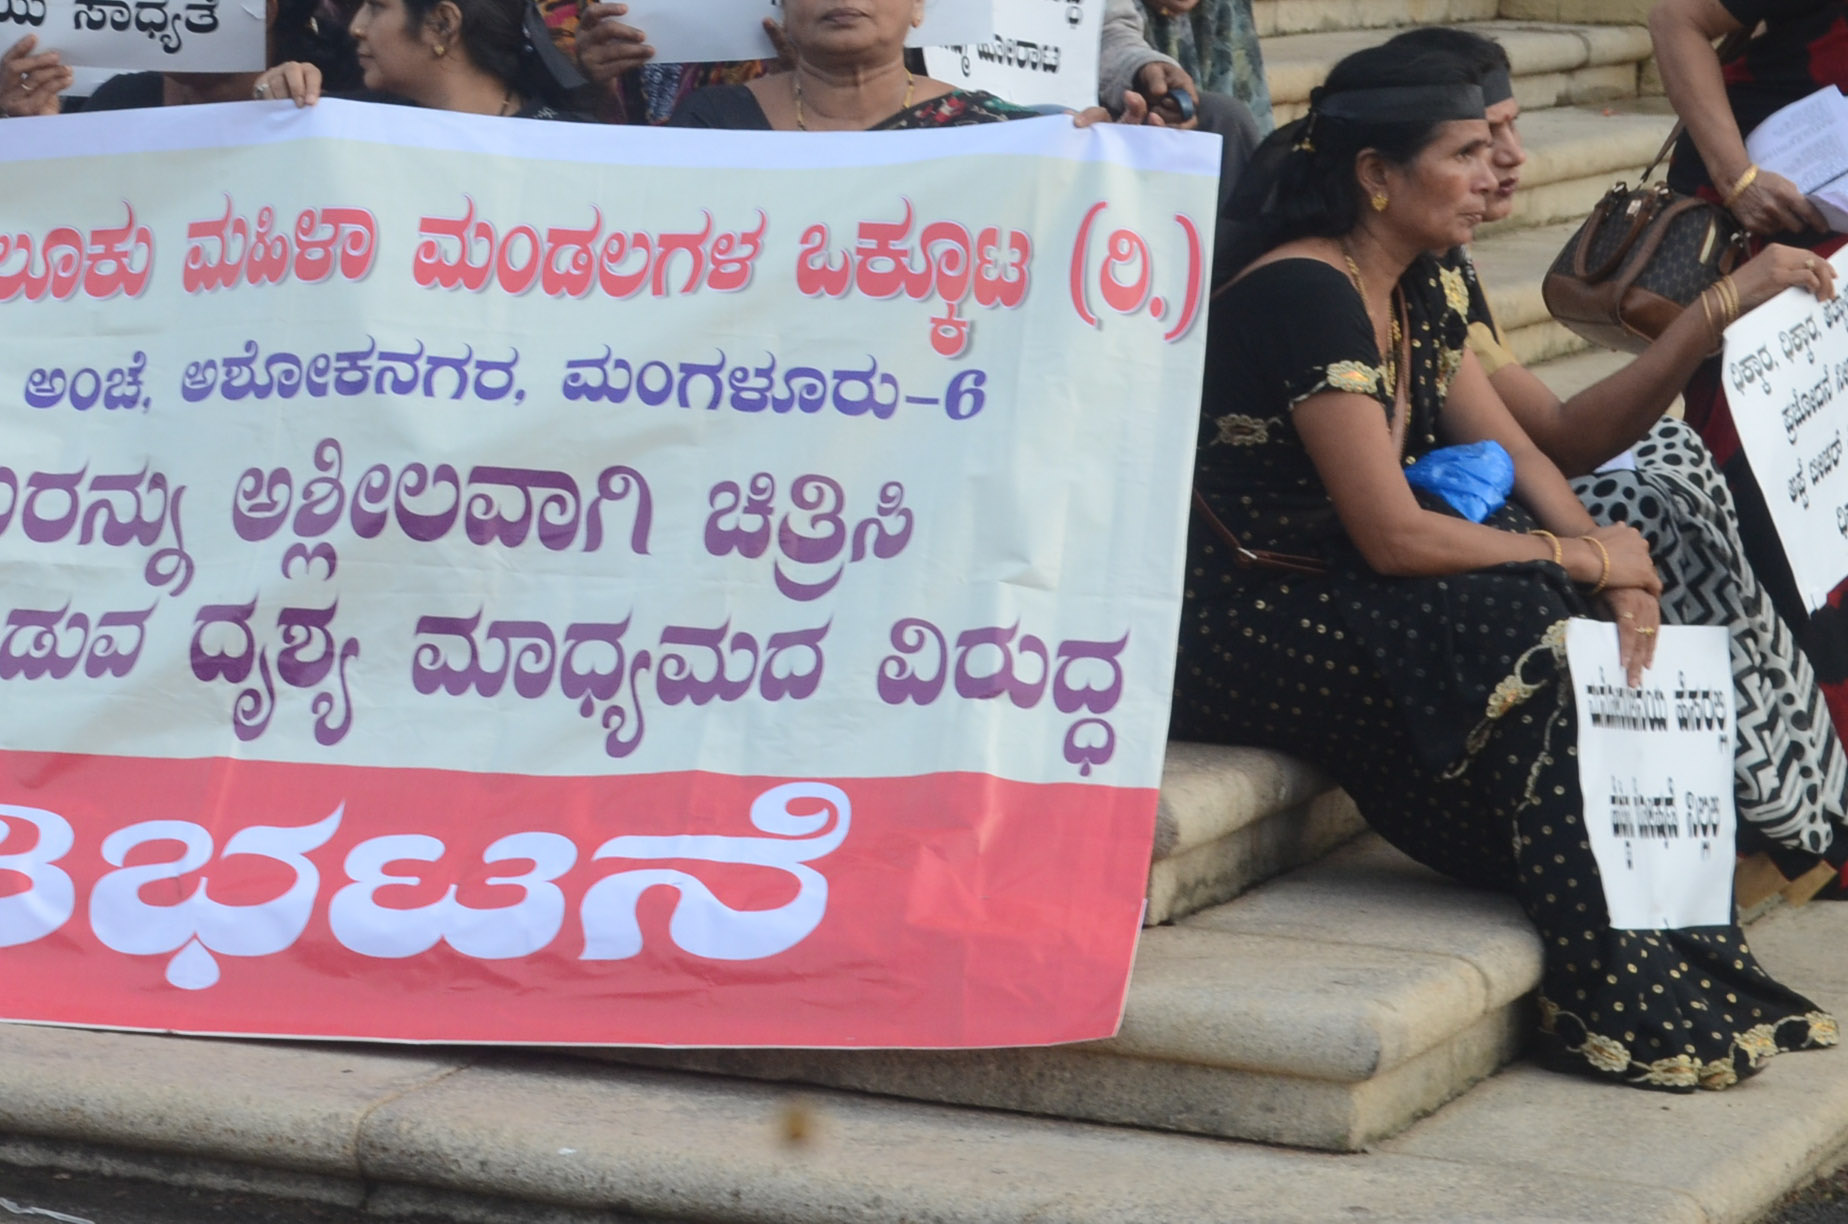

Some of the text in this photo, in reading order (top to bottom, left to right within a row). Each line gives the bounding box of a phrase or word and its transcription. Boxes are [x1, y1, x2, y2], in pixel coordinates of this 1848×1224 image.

[182, 191, 379, 294] ಮಹಿಳಾ
[411, 195, 767, 300] ಮಂಡಲಗಳ
[796, 196, 1033, 359] ಒಕ್ಕೂಟ
[1070, 201, 1203, 343] (ರಿ.)
[23, 351, 152, 414] ಅಂಚೆ,
[180, 333, 527, 407] ಅಶೋಕನಗರ,
[232, 437, 654, 582] ಅಶ್ಲೀಲವಾಗಿ
[703, 471, 916, 603] ಚಿತ್ರಿಸಿ
[188, 592, 361, 747] ದೃಶ್ಯ
[411, 604, 833, 760] ಮಾಧ್ಯಮದ
[877, 616, 1131, 777] ವಿರುದ್ಧ
